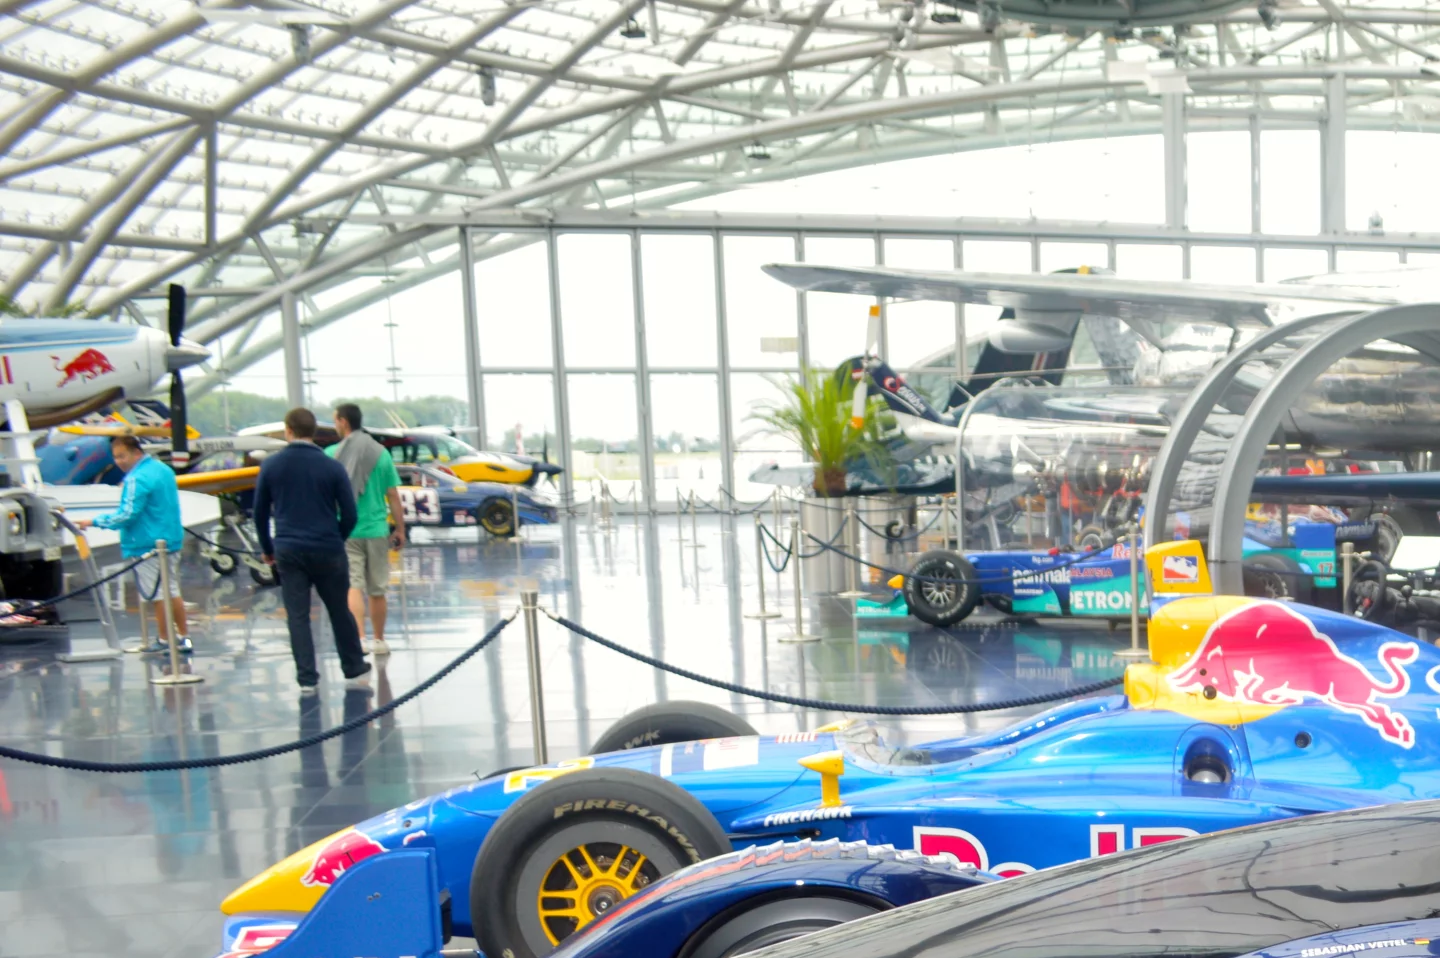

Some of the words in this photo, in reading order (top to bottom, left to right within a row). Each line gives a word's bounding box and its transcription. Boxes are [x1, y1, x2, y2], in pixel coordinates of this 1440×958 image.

[1318, 562, 1334, 580] 17
[764, 806, 853, 827] FIREHAWK
[553, 799, 703, 864] FIREHAWK
[1301, 943, 1366, 957] SEBASTIAN
[1368, 939, 1408, 949] VETTEL
